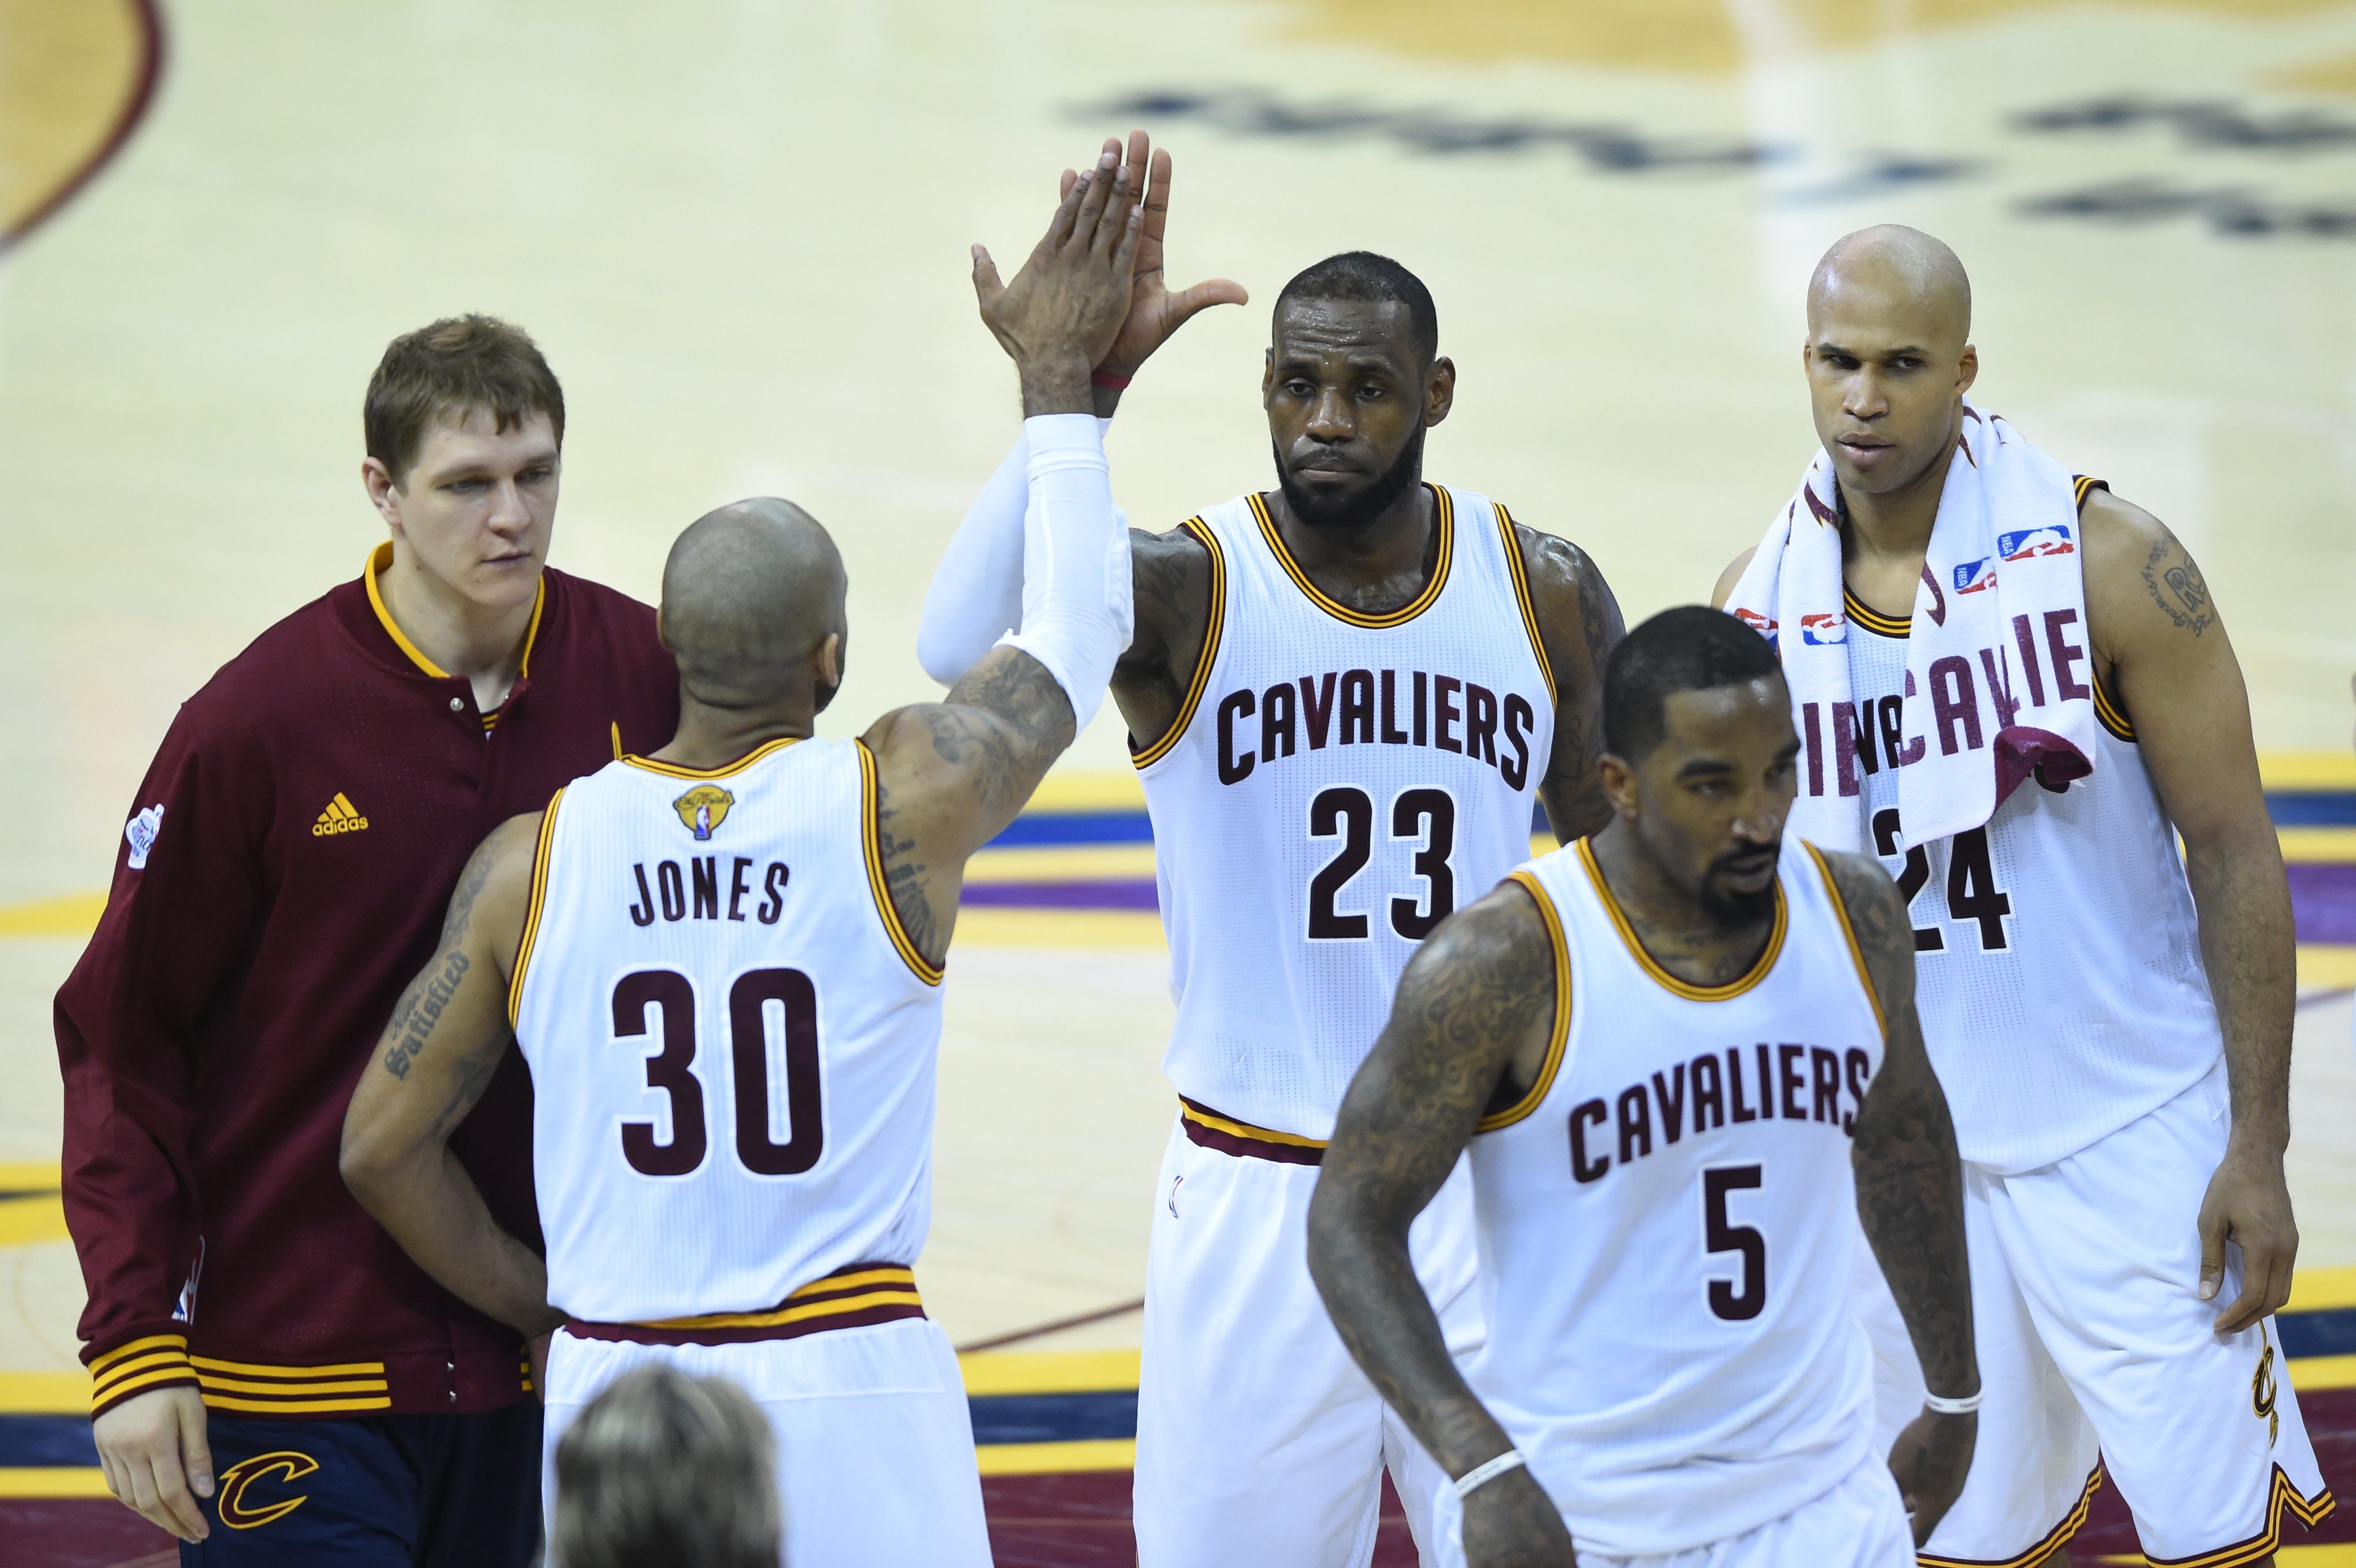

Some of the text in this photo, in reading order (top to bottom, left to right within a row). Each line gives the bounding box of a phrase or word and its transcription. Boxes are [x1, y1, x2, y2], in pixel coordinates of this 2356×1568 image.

[1956, 567, 1968, 587] NBA
[2000, 535, 2015, 555] NBA
[1217, 668, 1534, 792] CAVALIERS
[312, 816, 369, 837] adidas
[629, 856, 790, 927] JONES
[1308, 787, 1456, 940] 23
[1872, 808, 2011, 950] 24
[611, 967, 824, 1176] 30
[1567, 1043, 1870, 1184] CAVALIERS
[1703, 1163, 1766, 1321] 5
